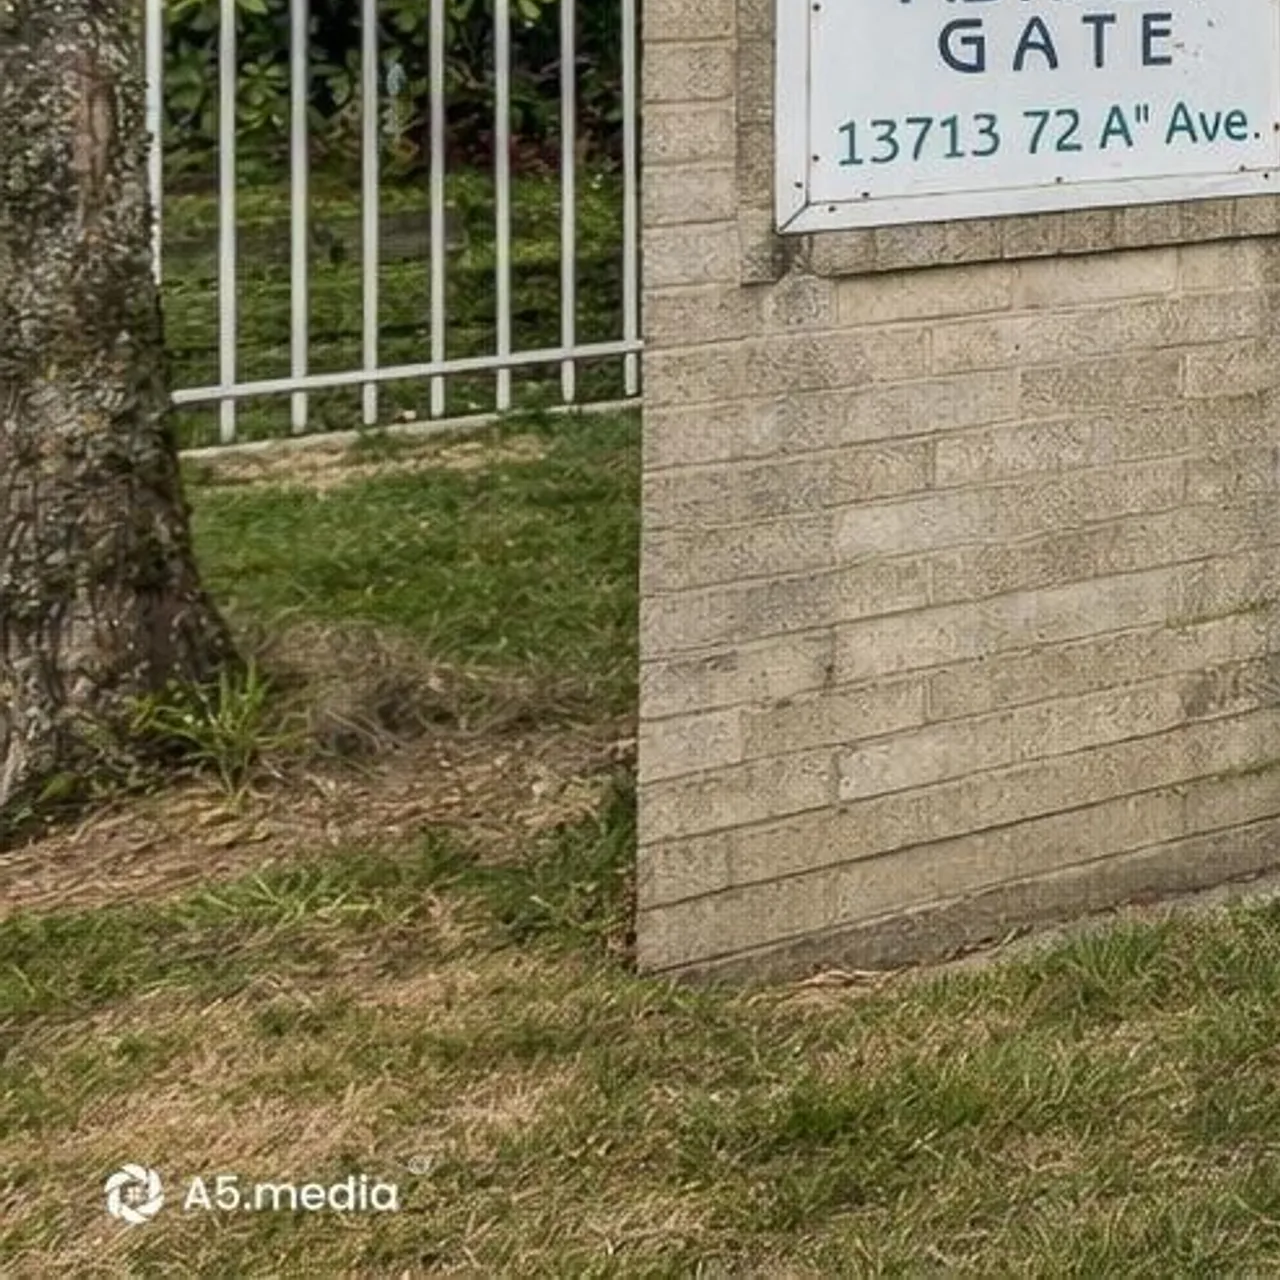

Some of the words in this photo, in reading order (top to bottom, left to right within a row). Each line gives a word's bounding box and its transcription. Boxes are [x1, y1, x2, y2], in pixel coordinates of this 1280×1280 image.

[938, 12, 1173, 73] GATE
[837, 113, 1001, 166] 13713
[1022, 108, 1083, 154] 72
